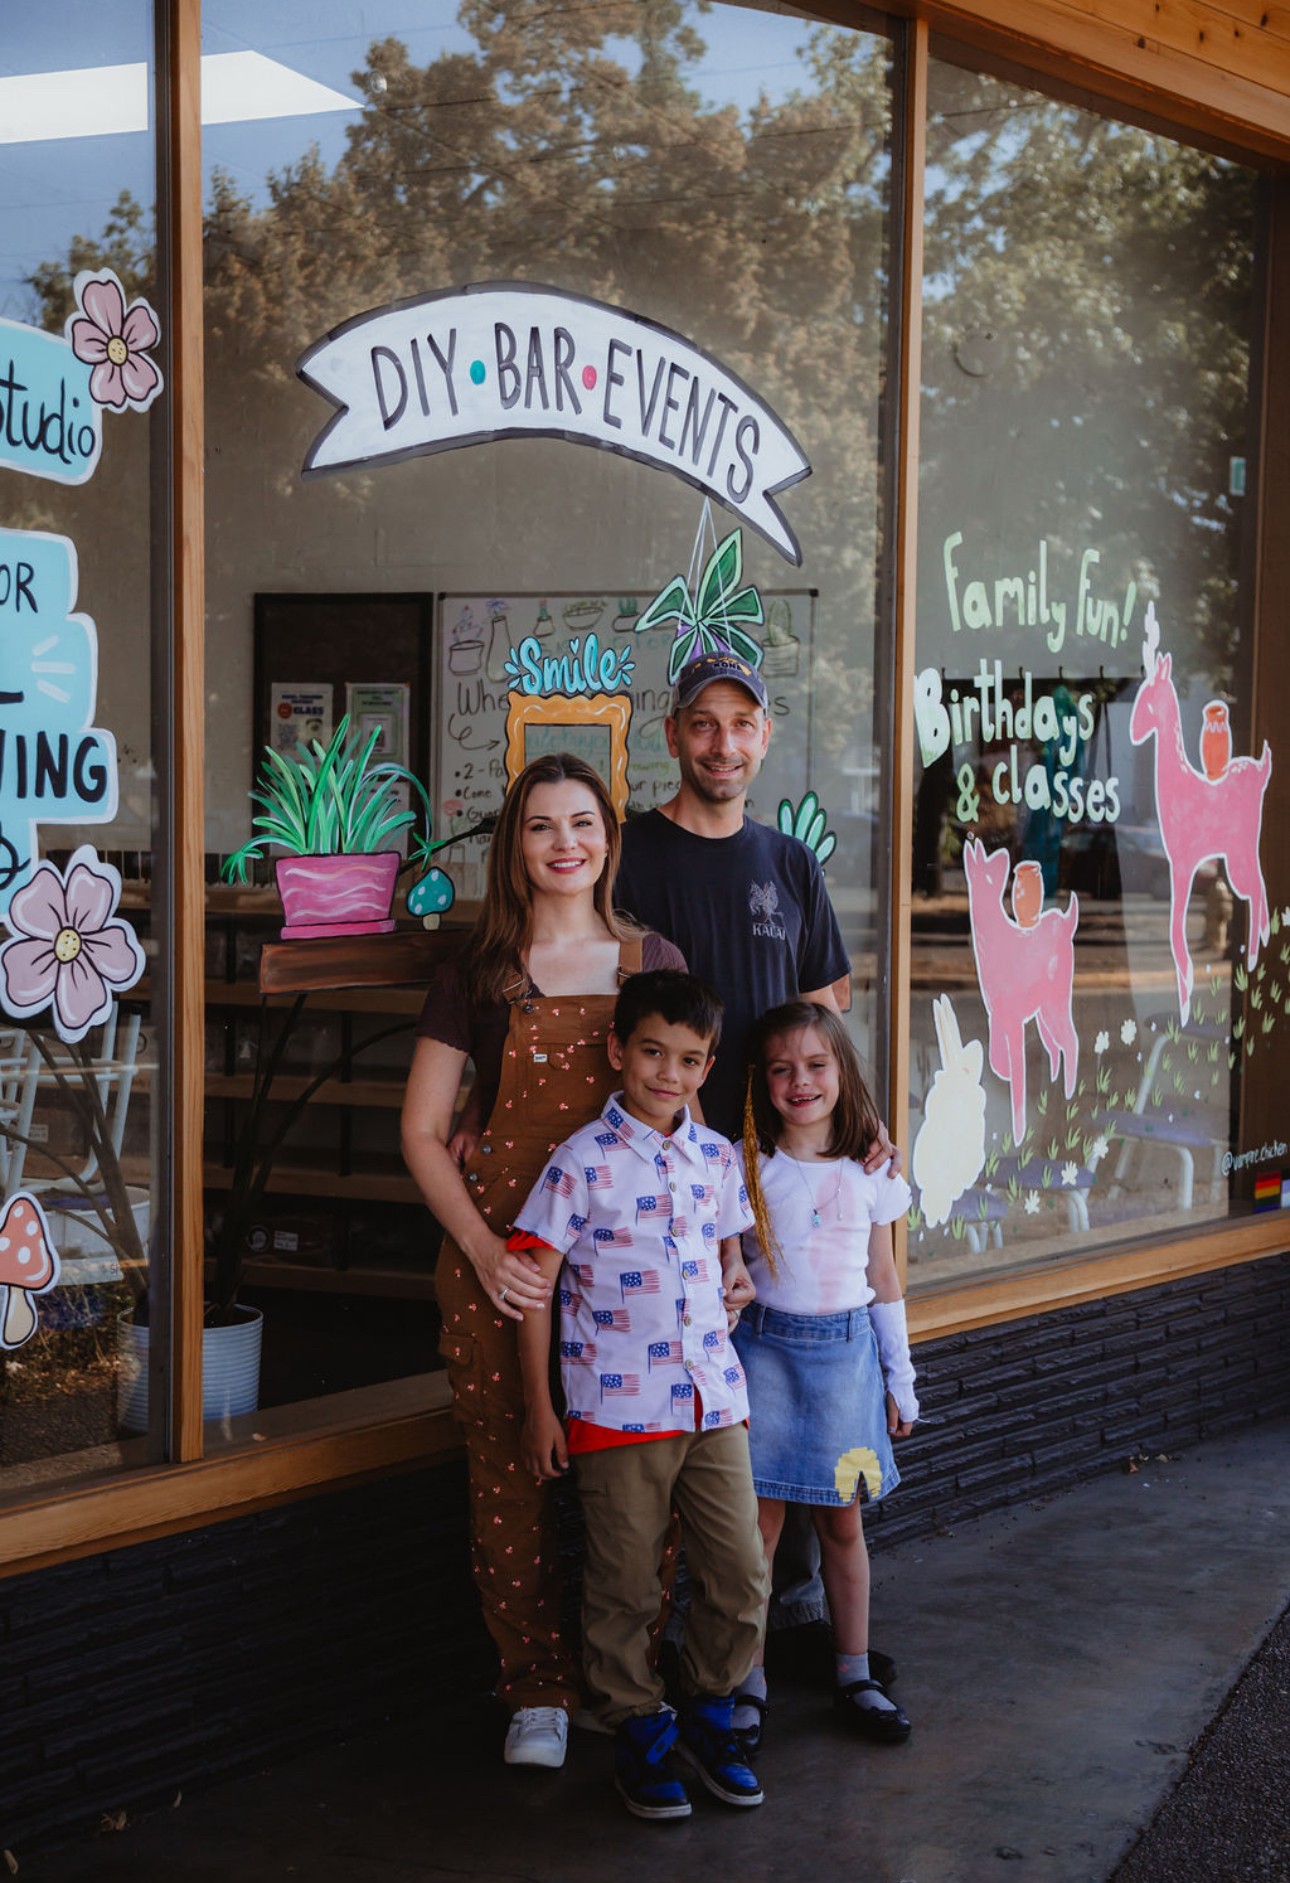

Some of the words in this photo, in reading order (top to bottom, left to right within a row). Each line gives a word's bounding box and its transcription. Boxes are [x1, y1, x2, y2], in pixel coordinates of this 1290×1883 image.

[0, 358, 96, 465] tudio
[371, 328, 457, 431] DIY
[494, 322, 582, 415] BAR
[603, 338, 760, 503] EVENTS
[943, 531, 1067, 653] Family
[519, 632, 623, 696] Smile
[914, 658, 1095, 769] Birthdays
[0, 730, 107, 803] ING
[956, 763, 980, 823] &
